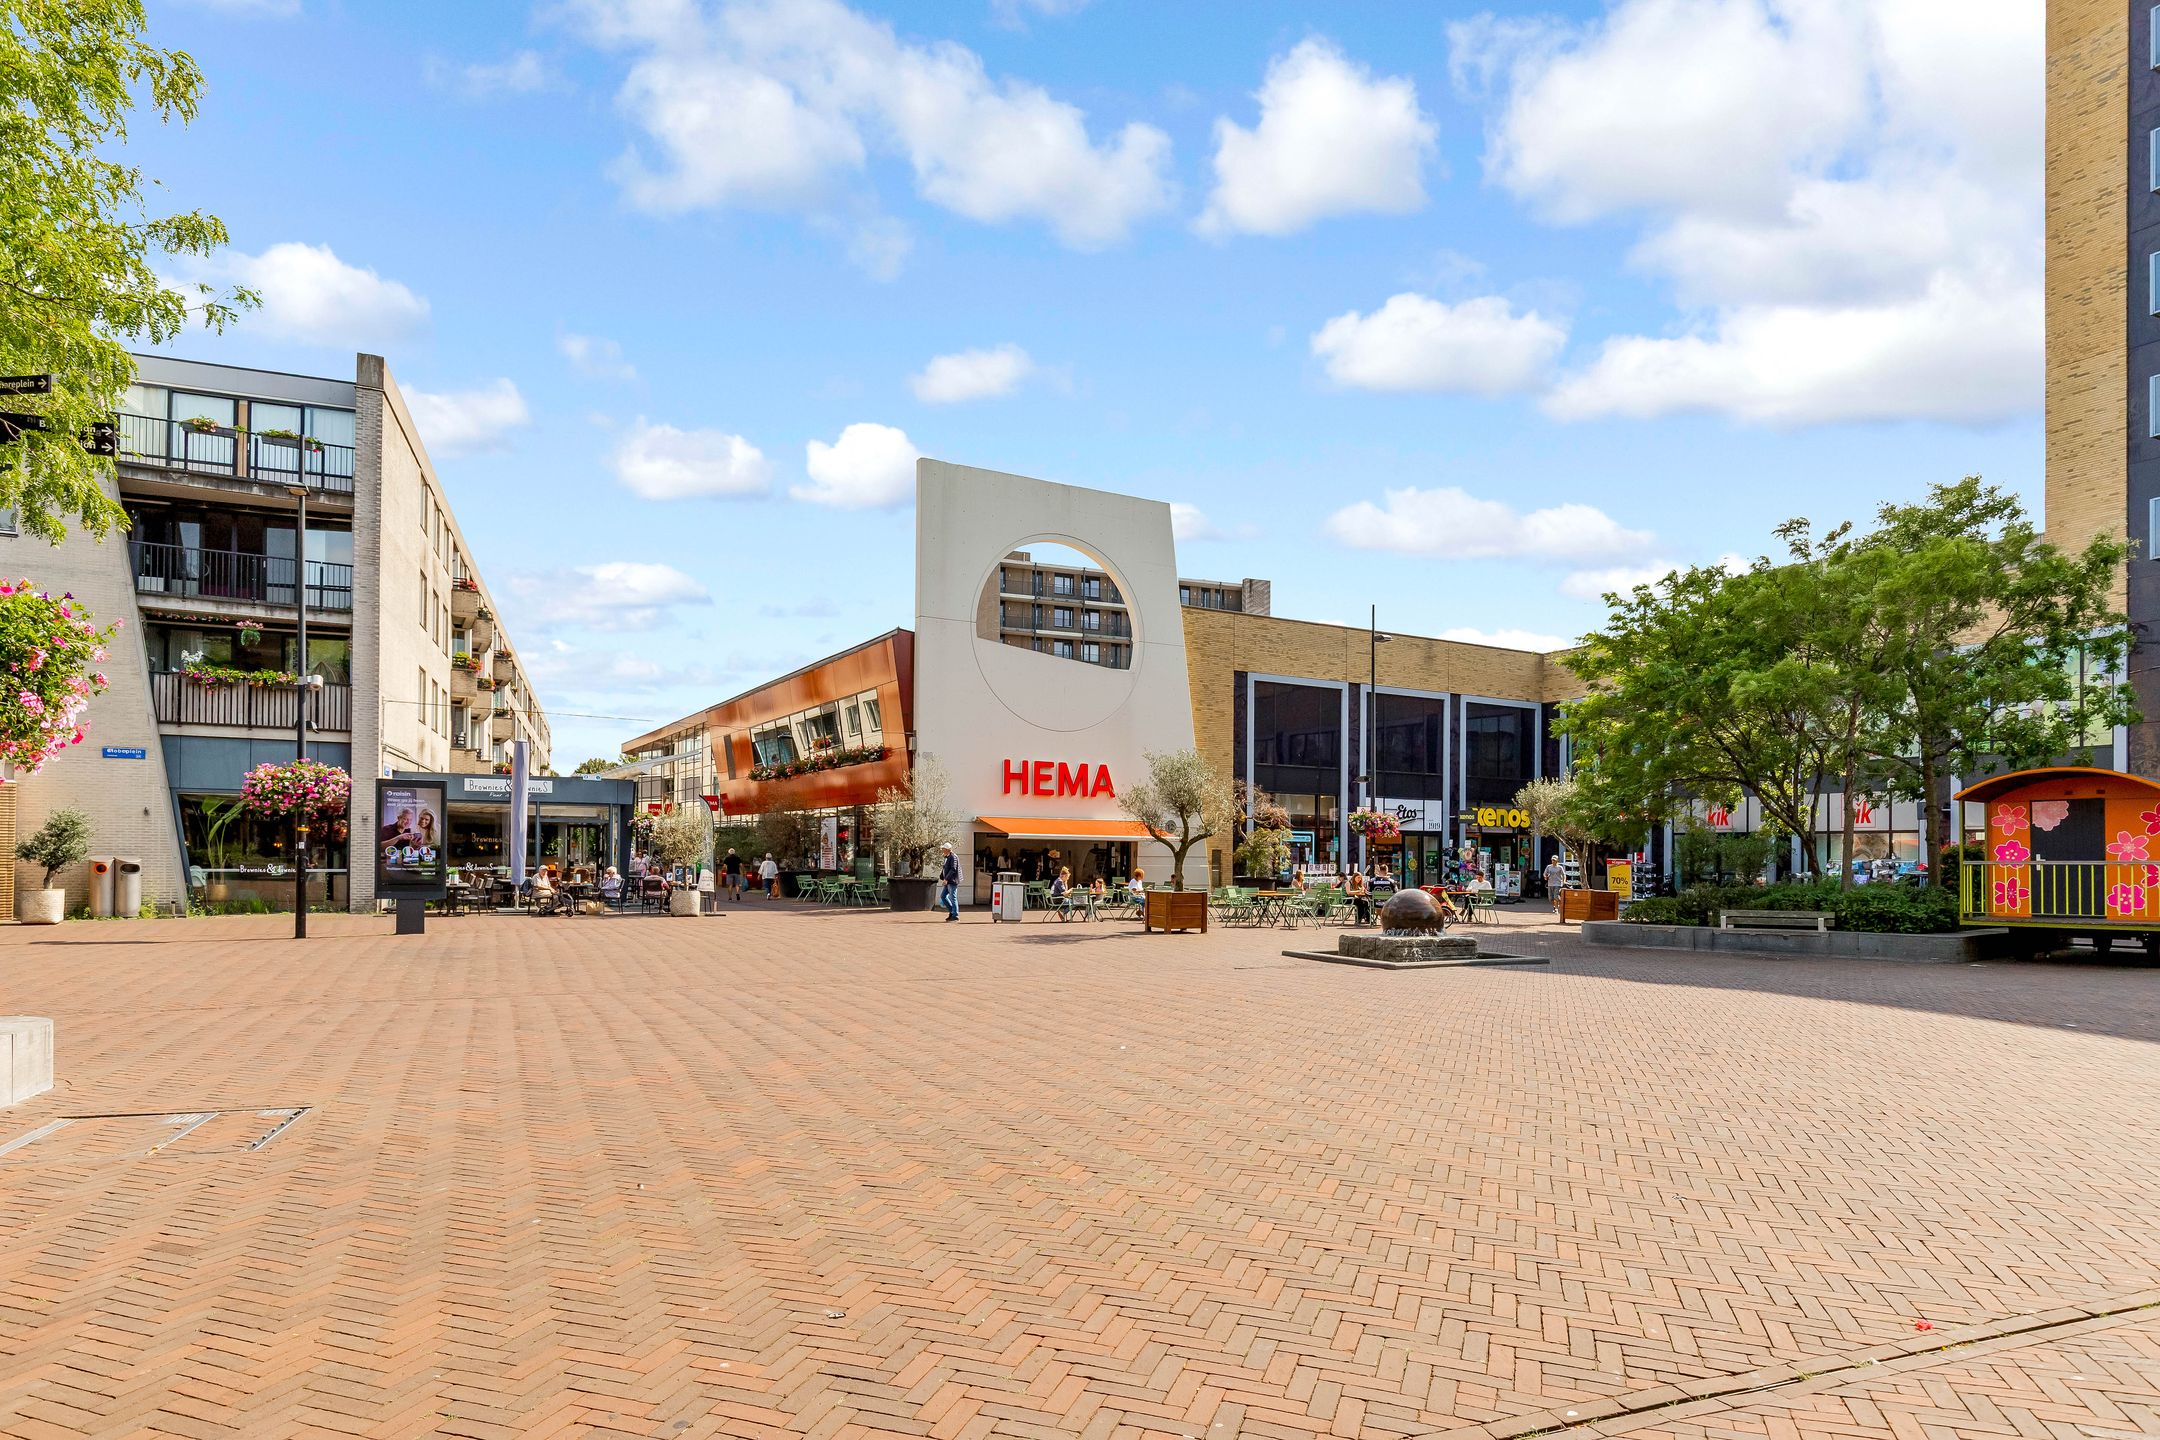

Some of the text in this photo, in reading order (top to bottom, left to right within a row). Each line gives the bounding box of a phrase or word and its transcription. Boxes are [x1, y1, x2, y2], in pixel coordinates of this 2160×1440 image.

[469, 779, 503, 791] Brownies
[1003, 759, 1115, 798] HEMA
[1396, 804, 1417, 819] Etos
[1472, 807, 1531, 828] xenos
[1855, 799, 1872, 824] ik
[1428, 822, 1441, 830] 1919
[239, 864, 266, 873] Brownies
[1611, 876, 1629, 885] 70%
